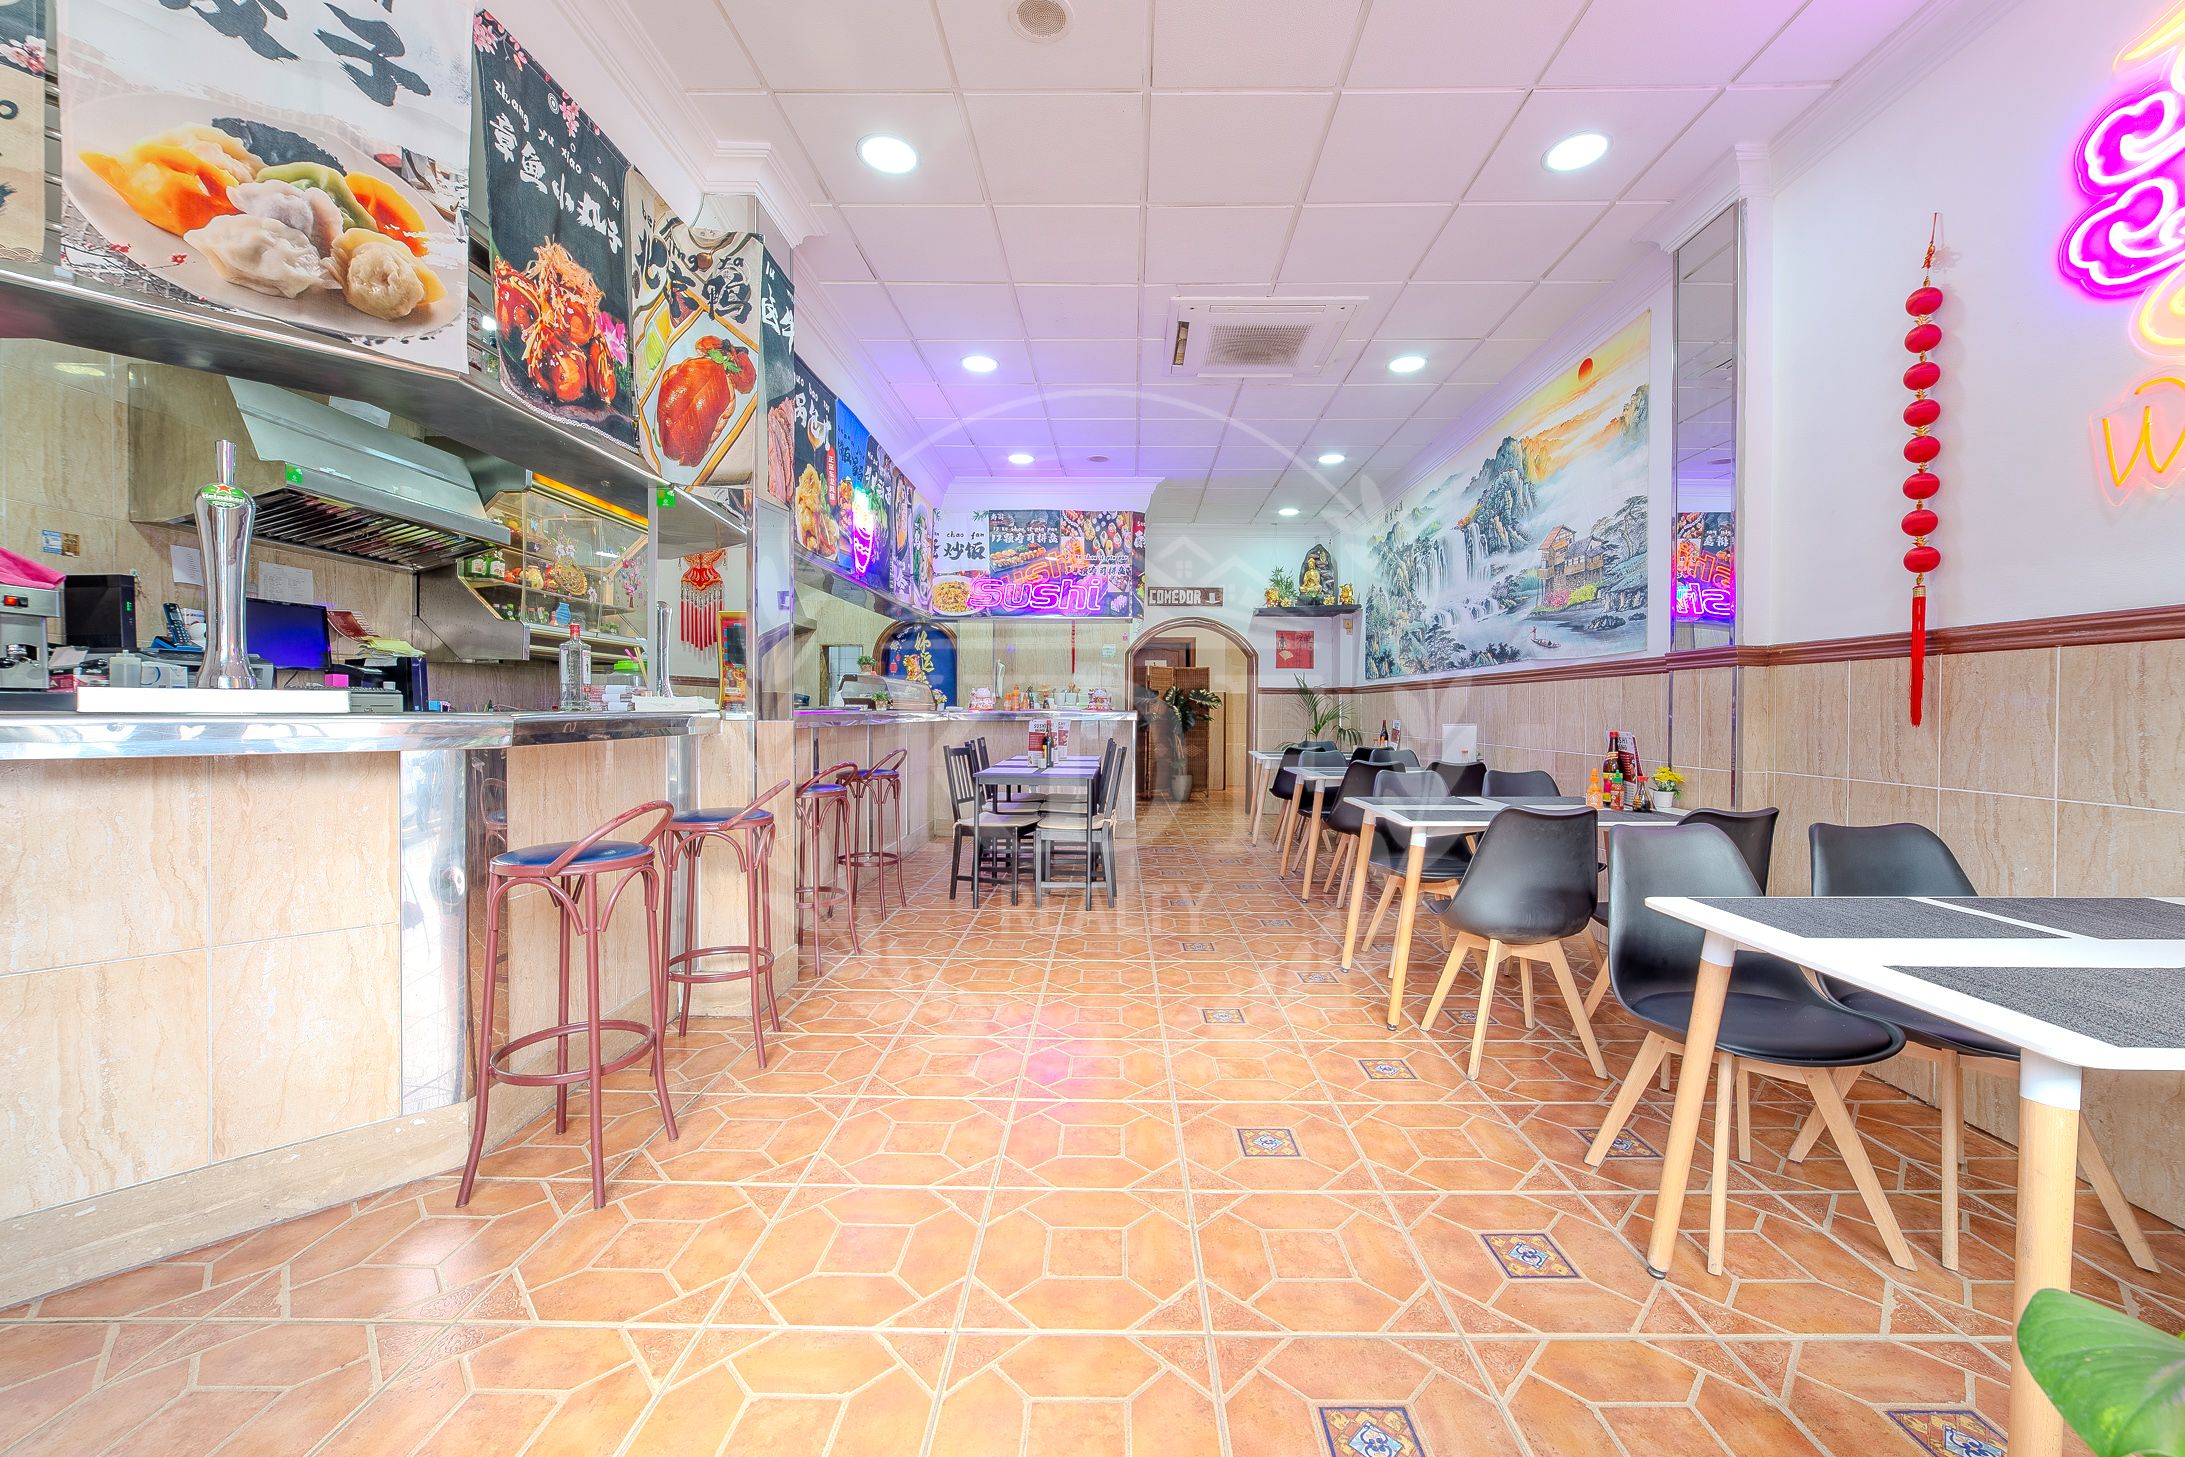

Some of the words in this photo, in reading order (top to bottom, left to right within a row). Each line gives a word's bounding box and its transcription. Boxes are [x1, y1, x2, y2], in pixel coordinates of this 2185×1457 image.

[494, 79, 530, 132] zhang
[538, 127, 554, 147] yu
[561, 147, 582, 174] xiao
[590, 172, 610, 197] wan
[612, 196, 620, 211] zi
[489, 112, 622, 254] 章鱼小丸子
[718, 256, 744, 270] ya
[765, 261, 775, 279] lu
[202, 493, 245, 503] Heineken
[971, 531, 985, 540] fan
[943, 541, 986, 560] 炒饭
[968, 578, 1101, 611] Sushi
[1149, 590, 1201, 605] COMEDOR
